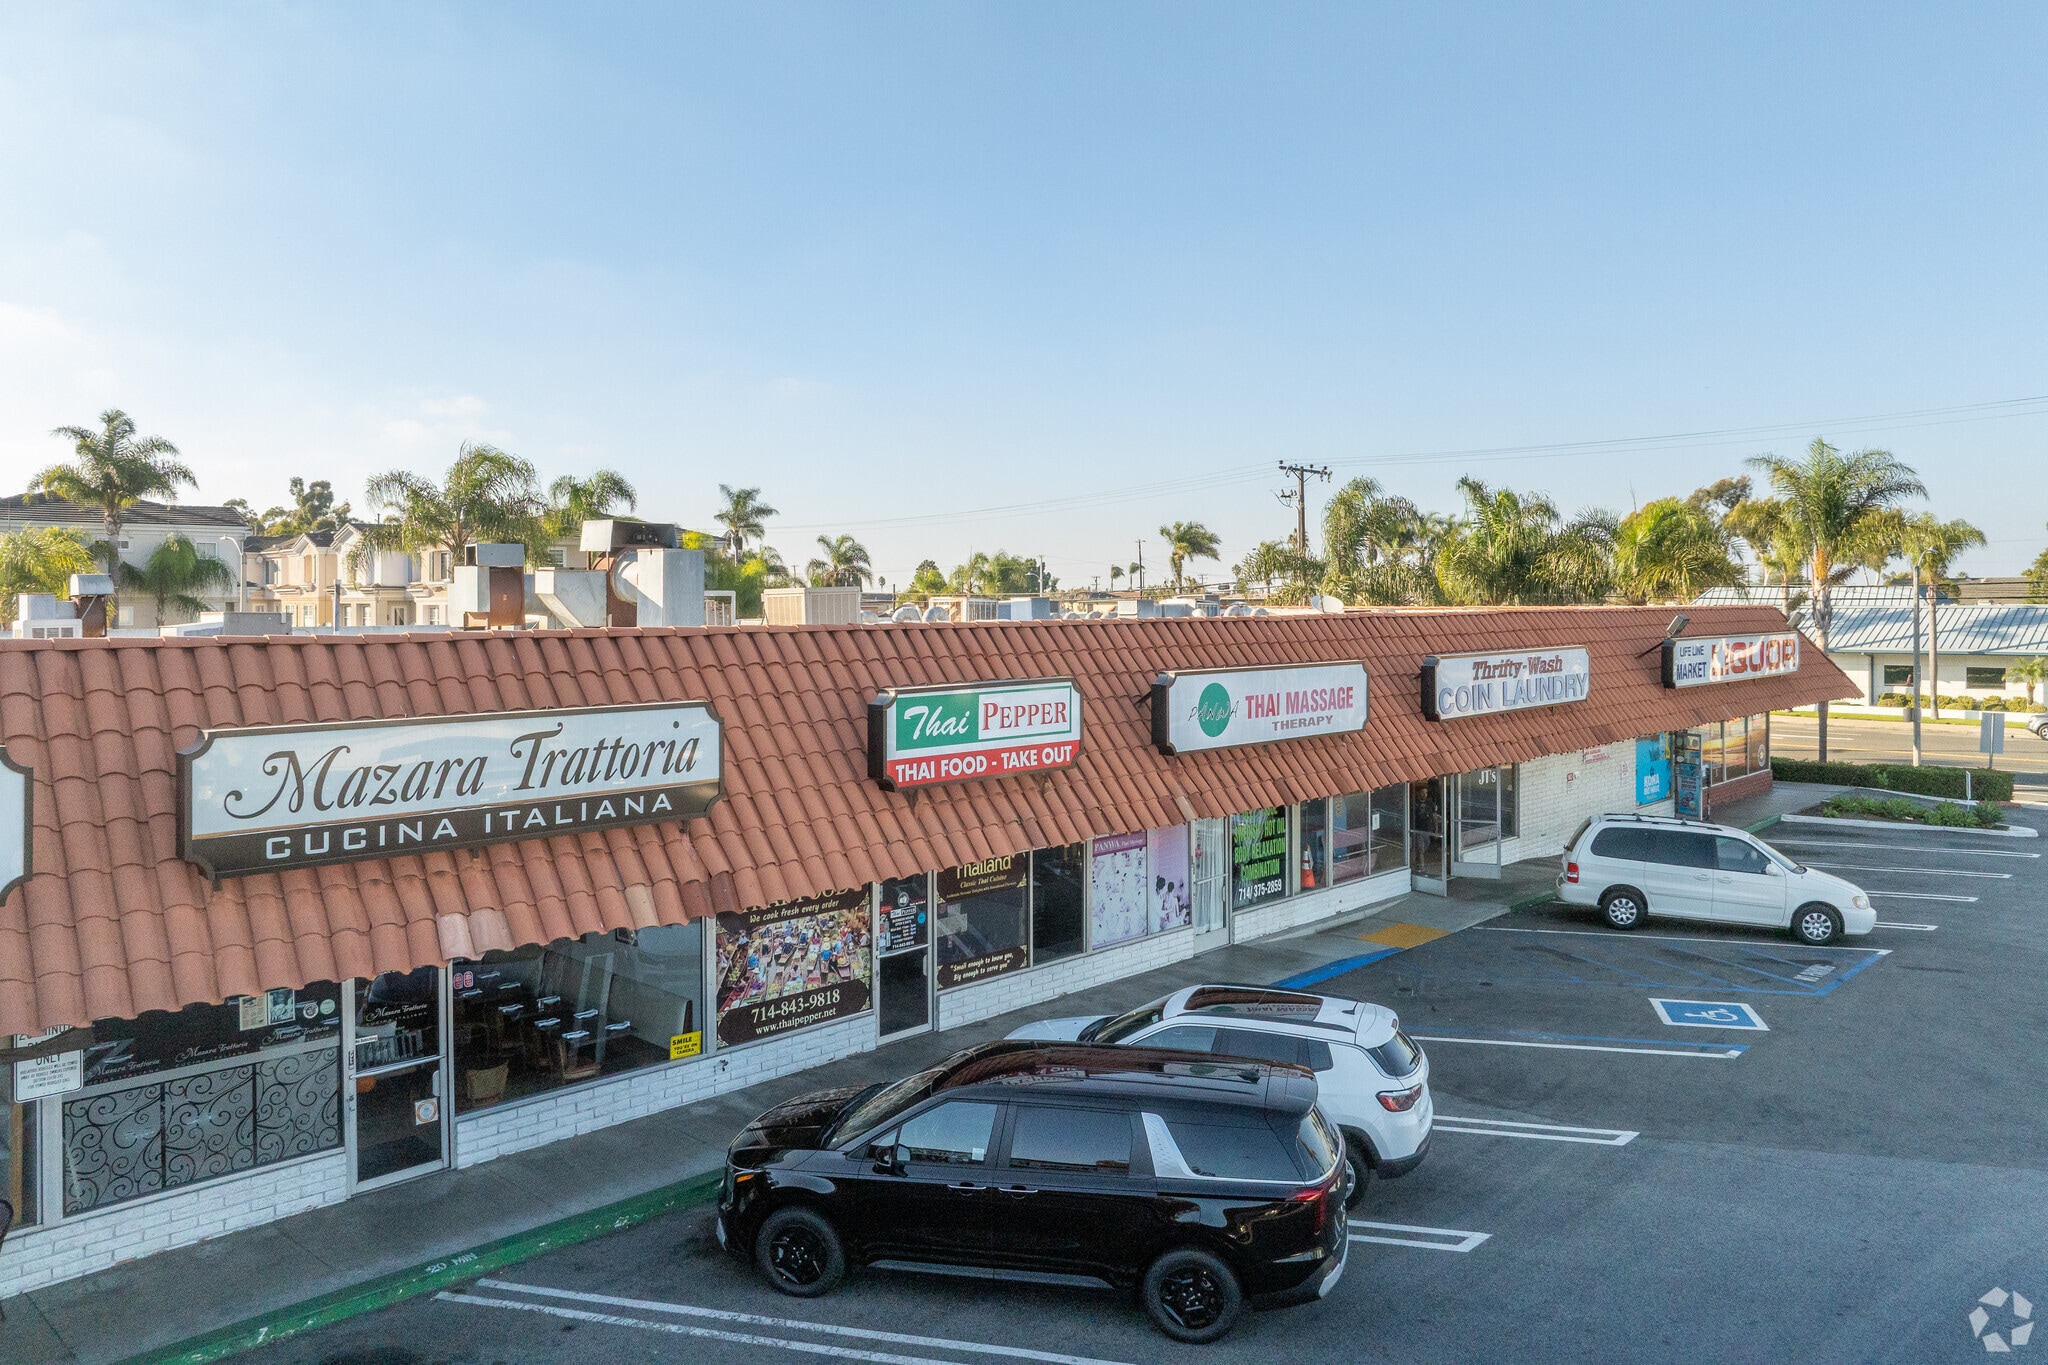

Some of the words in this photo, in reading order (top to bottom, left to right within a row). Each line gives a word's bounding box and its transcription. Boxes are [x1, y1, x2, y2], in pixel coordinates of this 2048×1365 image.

[1679, 646, 1691, 658] LIFE
[1692, 645, 1704, 656] LINE
[1711, 639, 1796, 677] LIQUOR
[1472, 654, 1563, 681] Thrifty-Wash
[1676, 662, 1707, 681] MARKET
[1245, 692, 1280, 720] THAI
[1285, 686, 1354, 715] MASSAGE
[1438, 682, 1493, 715] COIN
[1502, 672, 1588, 707] LAUNDRY
[903, 705, 970, 740] Thai
[982, 701, 1068, 732] PEPPER
[1271, 715, 1333, 731] THERAPY
[224, 745, 489, 819] Mazara
[510, 721, 701, 792] Trattoria
[895, 760, 935, 782] THAI
[940, 755, 987, 777] FOOD
[1001, 749, 1038, 769] TAKE
[1041, 745, 1073, 765] OUT
[1478, 769, 1496, 785] JT's
[265, 818, 458, 860] CUCINA
[485, 793, 673, 833] ITALIANA
[1264, 819, 1275, 837] HOT
[1276, 817, 1286, 834] OIL
[1094, 840, 1120, 852] PANWA
[1251, 837, 1286, 860] RELAXATION
[978, 877, 989, 886] Thai
[1241, 858, 1280, 882] COMBINATION
[749, 914, 760, 924] We
[763, 911, 779, 921] cook
[780, 905, 800, 918] fresh
[801, 904, 820, 915] every
[821, 899, 840, 910] order
[962, 969, 979, 978] enough
[967, 958, 984, 968] enough
[751, 988, 840, 1024] 714-843-9818
[755, 1007, 836, 1035] www.thaipepper.net
[672, 1036, 692, 1046] SMILE
